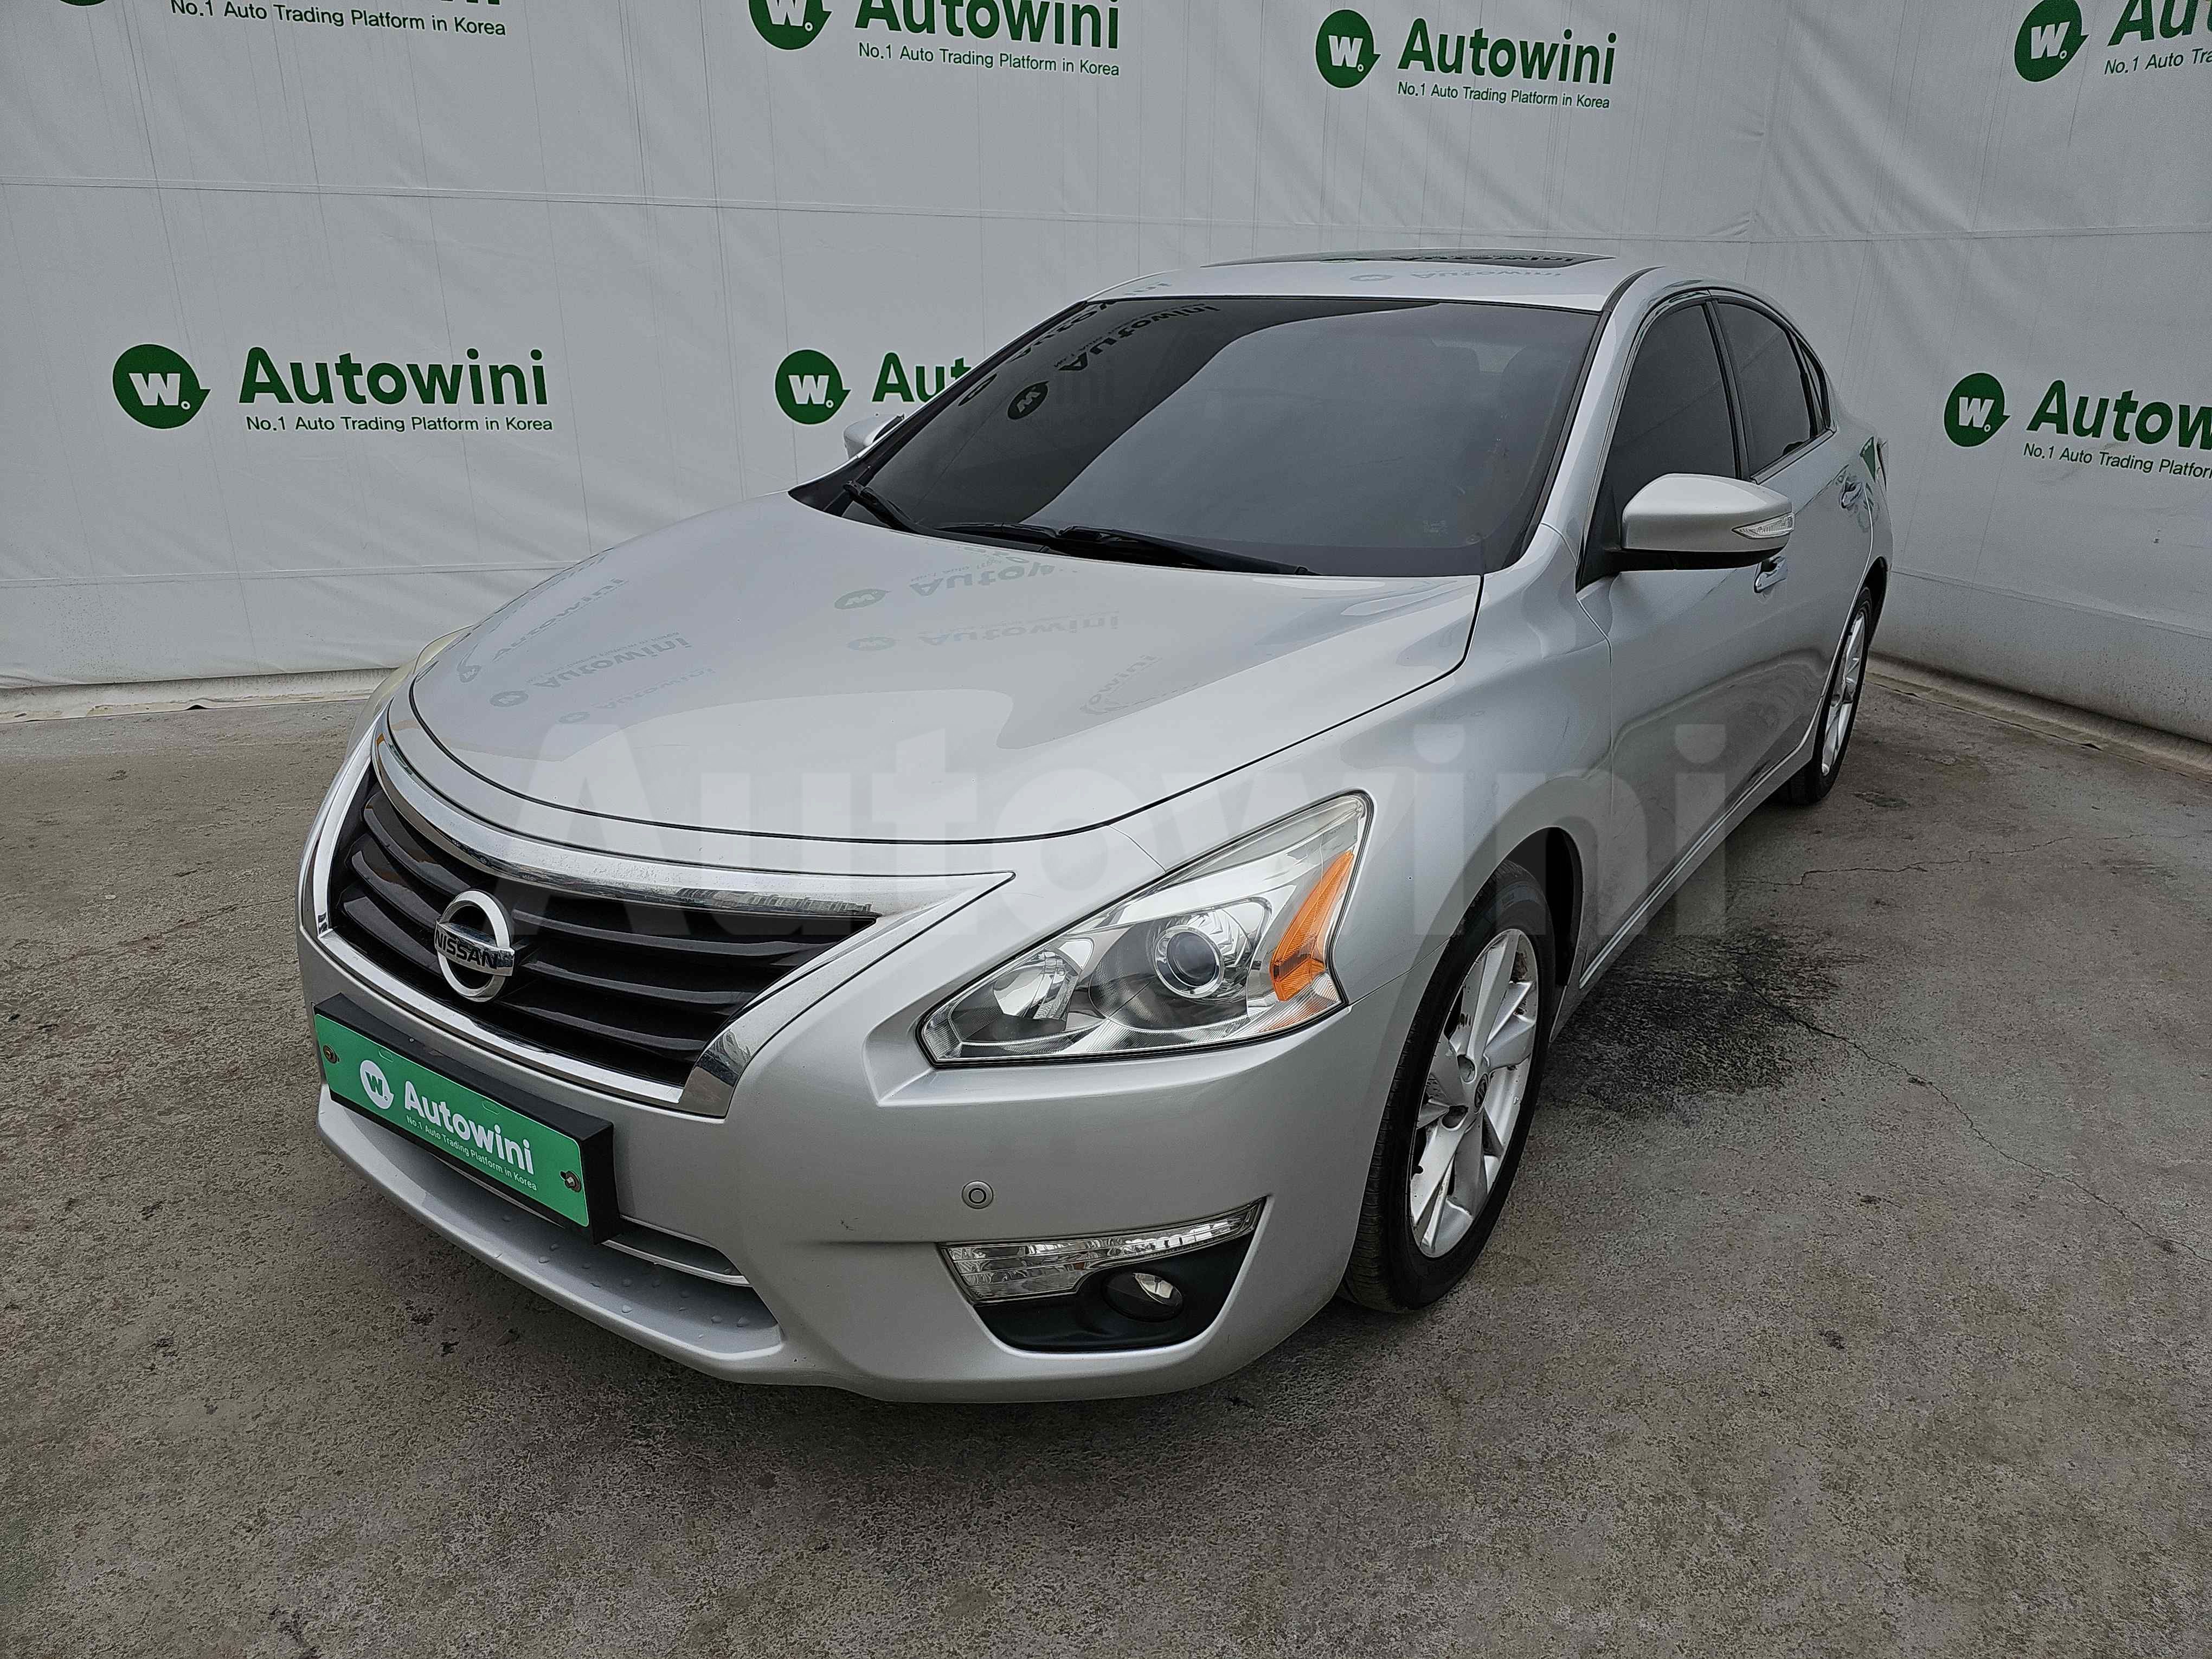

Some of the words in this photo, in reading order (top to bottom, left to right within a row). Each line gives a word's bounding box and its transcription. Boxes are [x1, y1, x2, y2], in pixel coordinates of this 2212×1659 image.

[171, 0, 213, 16] No.1
[224, 2, 267, 20] Auto
[273, 4, 344, 27] Trading
[351, 10, 425, 30] Platform
[432, 15, 447, 31] in
[454, 17, 506, 36] Korea
[2107, 0, 2212, 47] Au
[859, 42, 891, 59] No.1
[899, 46, 934, 62] Auto
[939, 49, 993, 69] Trading
[1000, 53, 1056, 72] Platform
[1063, 60, 1074, 72] in
[1080, 60, 1119, 76] Korea
[1397, 18, 1617, 85] Autowini
[2104, 56, 2139, 75] No.1
[2145, 53, 2184, 70] Auto
[1398, 82, 1425, 97] No.1
[1431, 84, 1458, 99] Auto
[1463, 87, 1507, 104] Trading
[1511, 90, 1558, 106] Platform
[1562, 95, 1572, 106] in
[1577, 94, 1610, 108] Korea
[239, 347, 548, 405] Autowini
[247, 416, 286, 430] No.1
[295, 417, 335, 430] Auto
[340, 416, 405, 432] Trading
[411, 416, 479, 430] Platform
[485, 417, 499, 430] in
[505, 417, 553, 431] Korea
[2023, 443, 2054, 460] No.1
[2059, 447, 2093, 464] Auto
[2099, 451, 2153, 473] Trading
[2158, 459, 2212, 479] Platfor
[435, 930, 498, 970] NISSAN
[404, 1081, 534, 1175] Autowini
[406, 1115, 423, 1130] No.1
[425, 1125, 441, 1140] Auto
[442, 1134, 470, 1157] Trading
[470, 1149, 503, 1173] Platform
[504, 1167, 512, 1179] in
[513, 1172, 537, 1191] Korea
